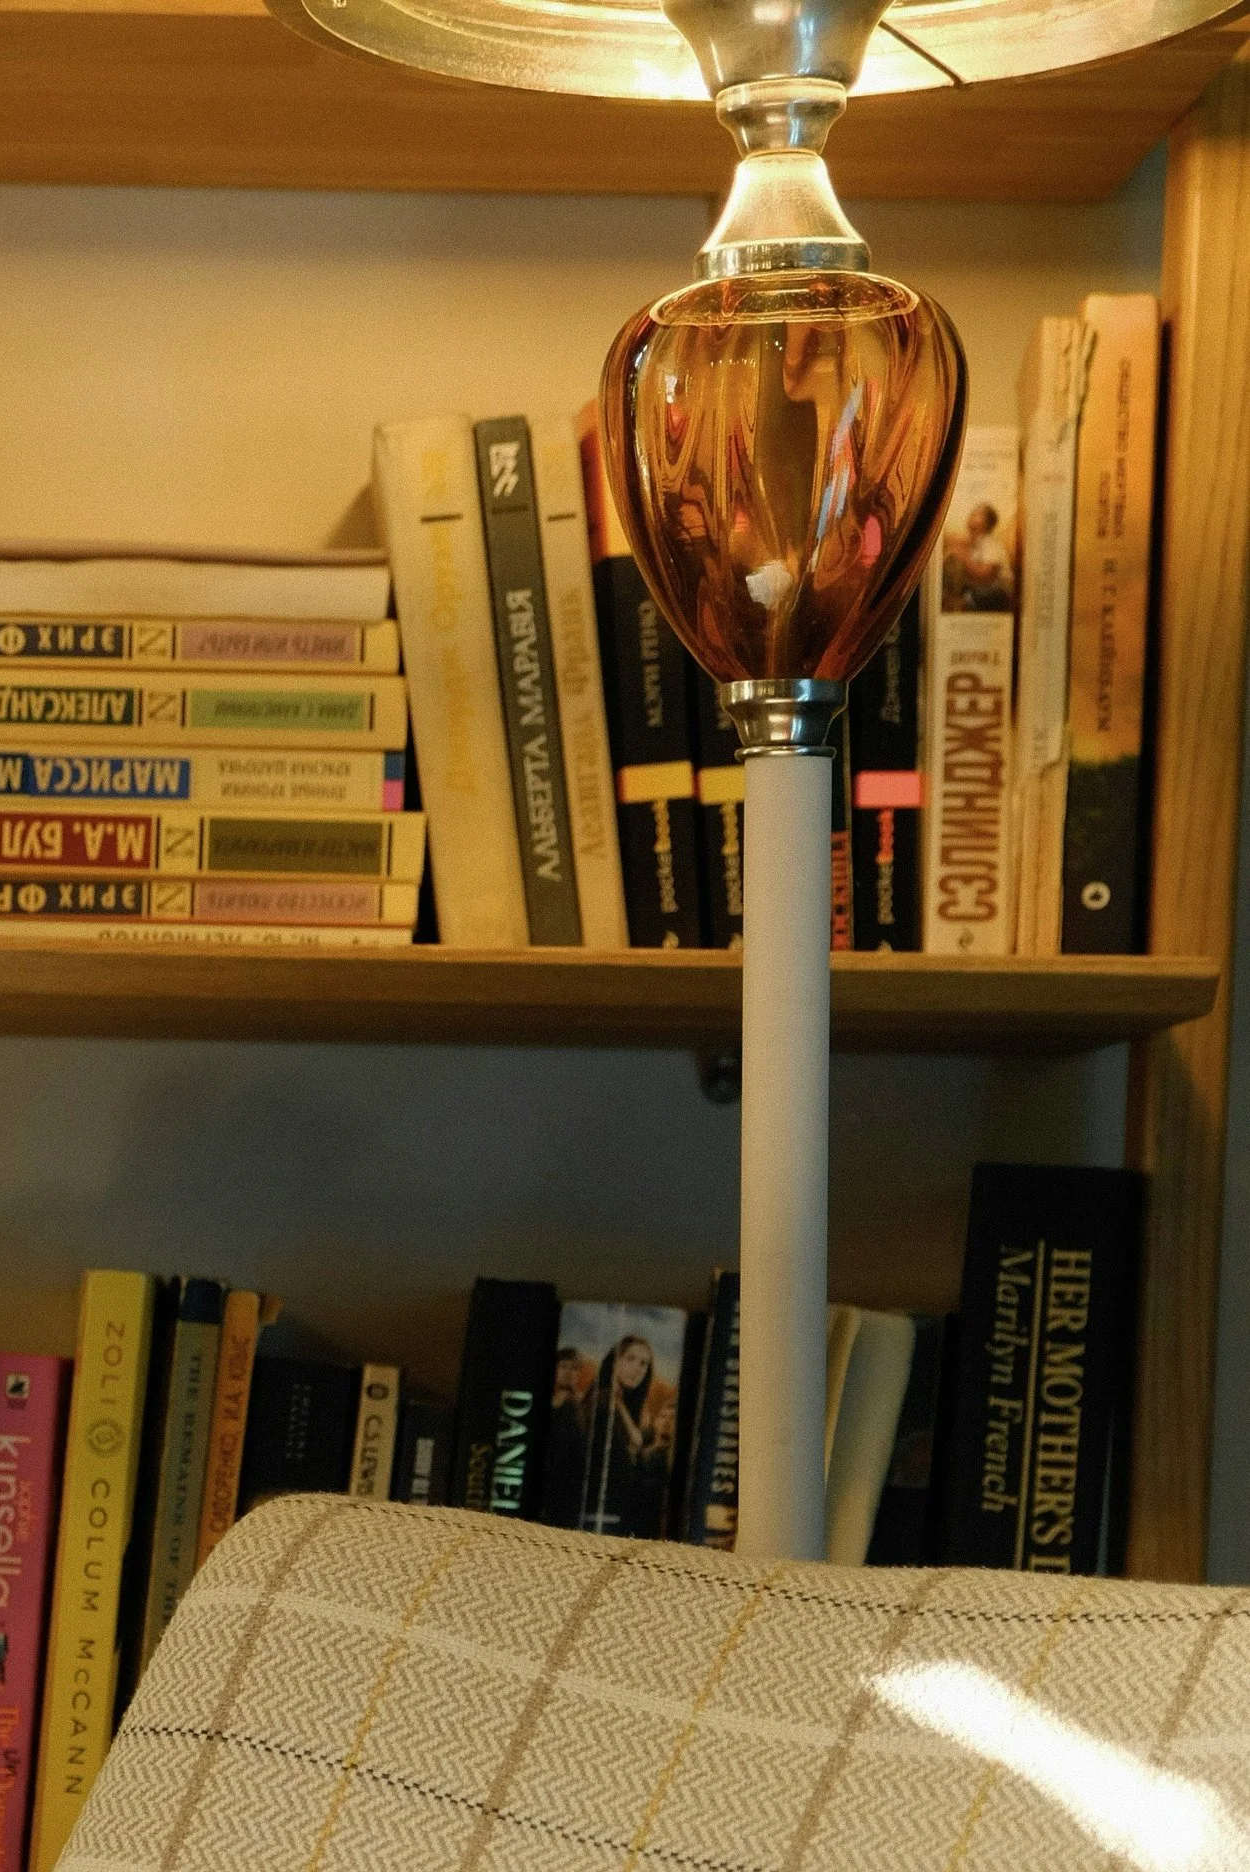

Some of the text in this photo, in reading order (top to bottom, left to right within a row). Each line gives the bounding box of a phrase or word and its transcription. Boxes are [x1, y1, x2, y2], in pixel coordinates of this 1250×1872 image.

[37, 626, 116, 652] ЭРИХ
[32, 757, 182, 794] МАРИССА
[522, 734, 562, 882] АЛЬБЕРТА
[936, 669, 1005, 922] СЭЛИНДЖЕР
[72, 822, 148, 862] М.А.
[58, 892, 141, 913] ЭРИХ
[1046, 1248, 1093, 1332] HER
[98, 1319, 127, 1406] ZOLI
[981, 1243, 1035, 1513] Marilyn French
[1030, 1340, 1087, 1545] MOTHER'S
[81, 1478, 113, 1613] COLUM
